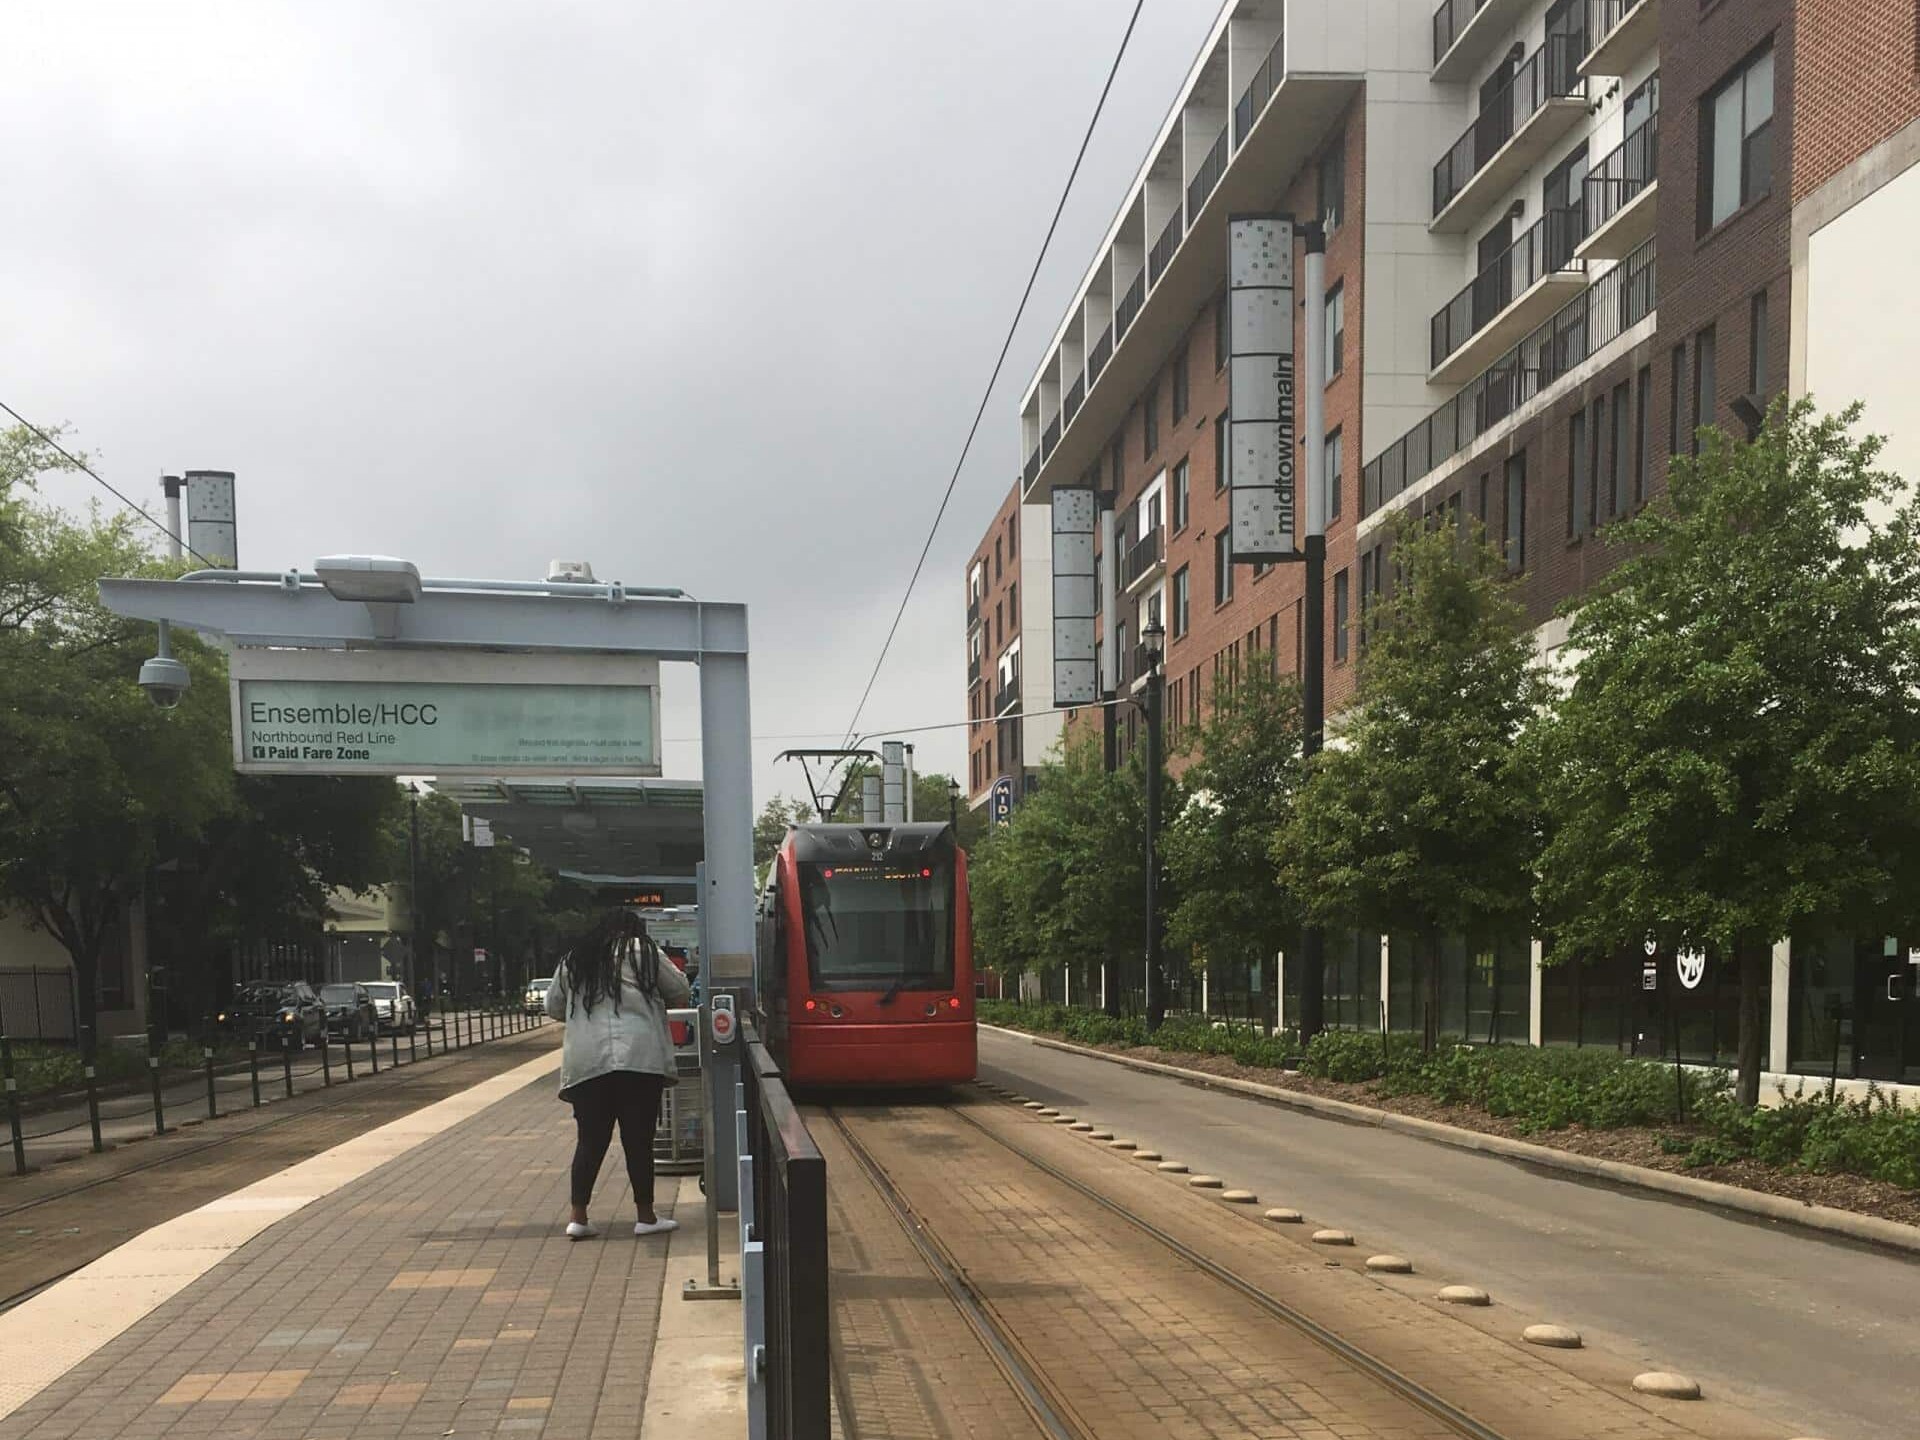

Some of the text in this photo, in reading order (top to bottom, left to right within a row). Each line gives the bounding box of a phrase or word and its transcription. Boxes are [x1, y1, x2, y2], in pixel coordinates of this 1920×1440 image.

[1273, 355, 1292, 534] midtownmain
[250, 702, 438, 726] Ensemble/HCC
[252, 731, 396, 745] Northbound Red Line
[269, 746, 370, 760] Paid Fare Zone
